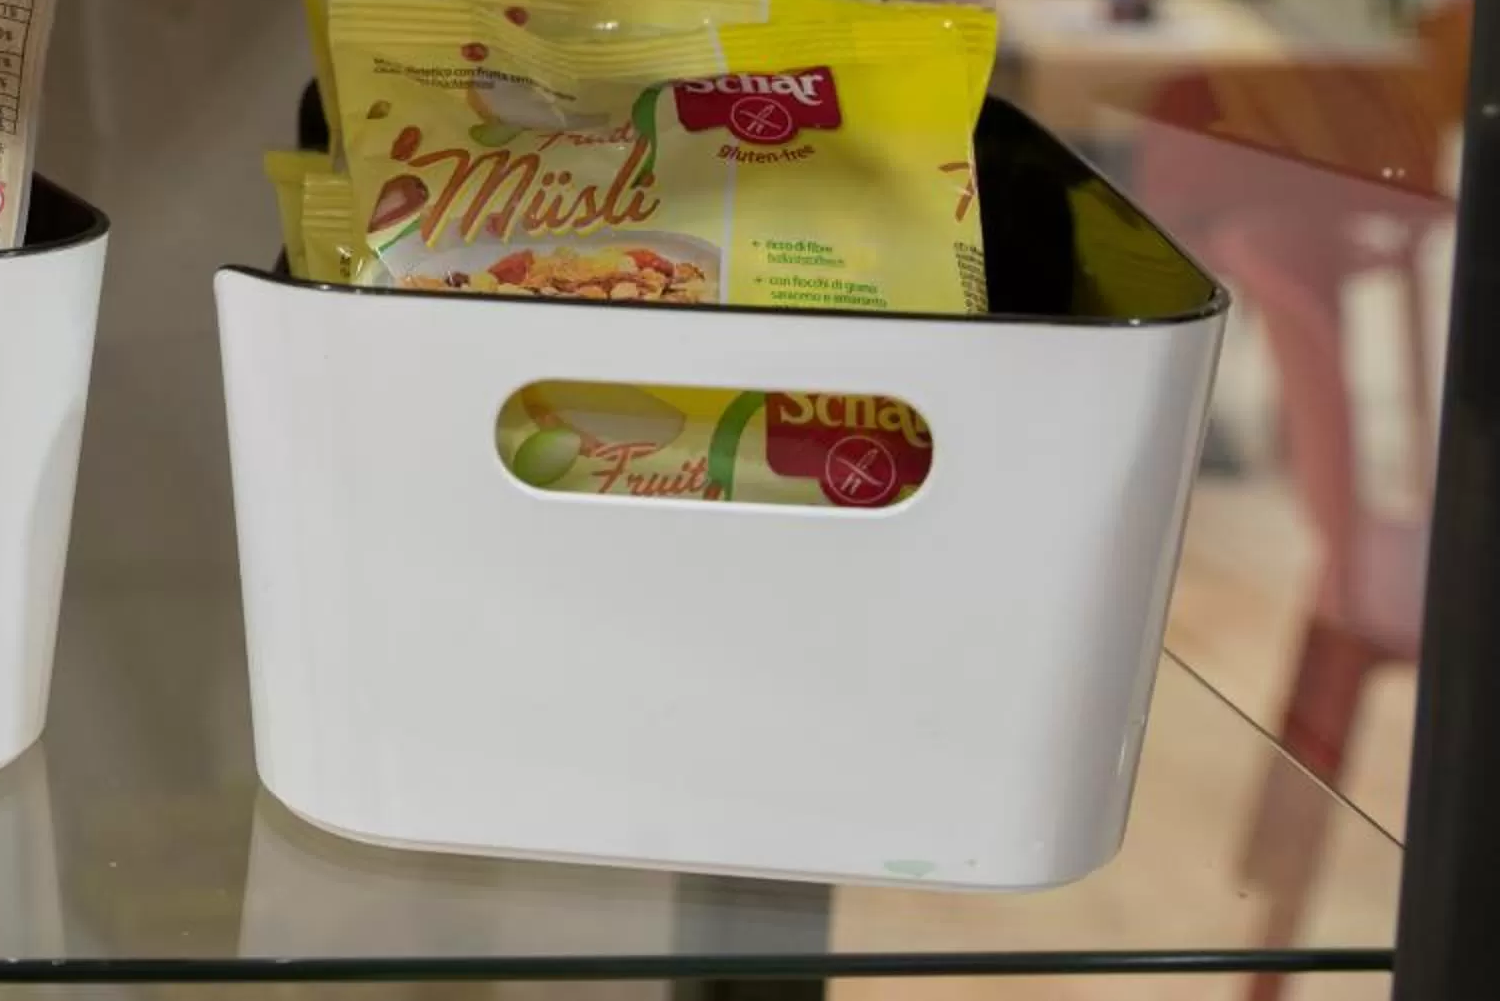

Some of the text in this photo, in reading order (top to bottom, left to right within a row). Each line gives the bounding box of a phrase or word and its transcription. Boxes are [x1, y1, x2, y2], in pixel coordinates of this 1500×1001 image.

[717, 144, 816, 165] gluten-free
[408, 135, 661, 245] Müsli
[590, 443, 708, 497] Fruit
